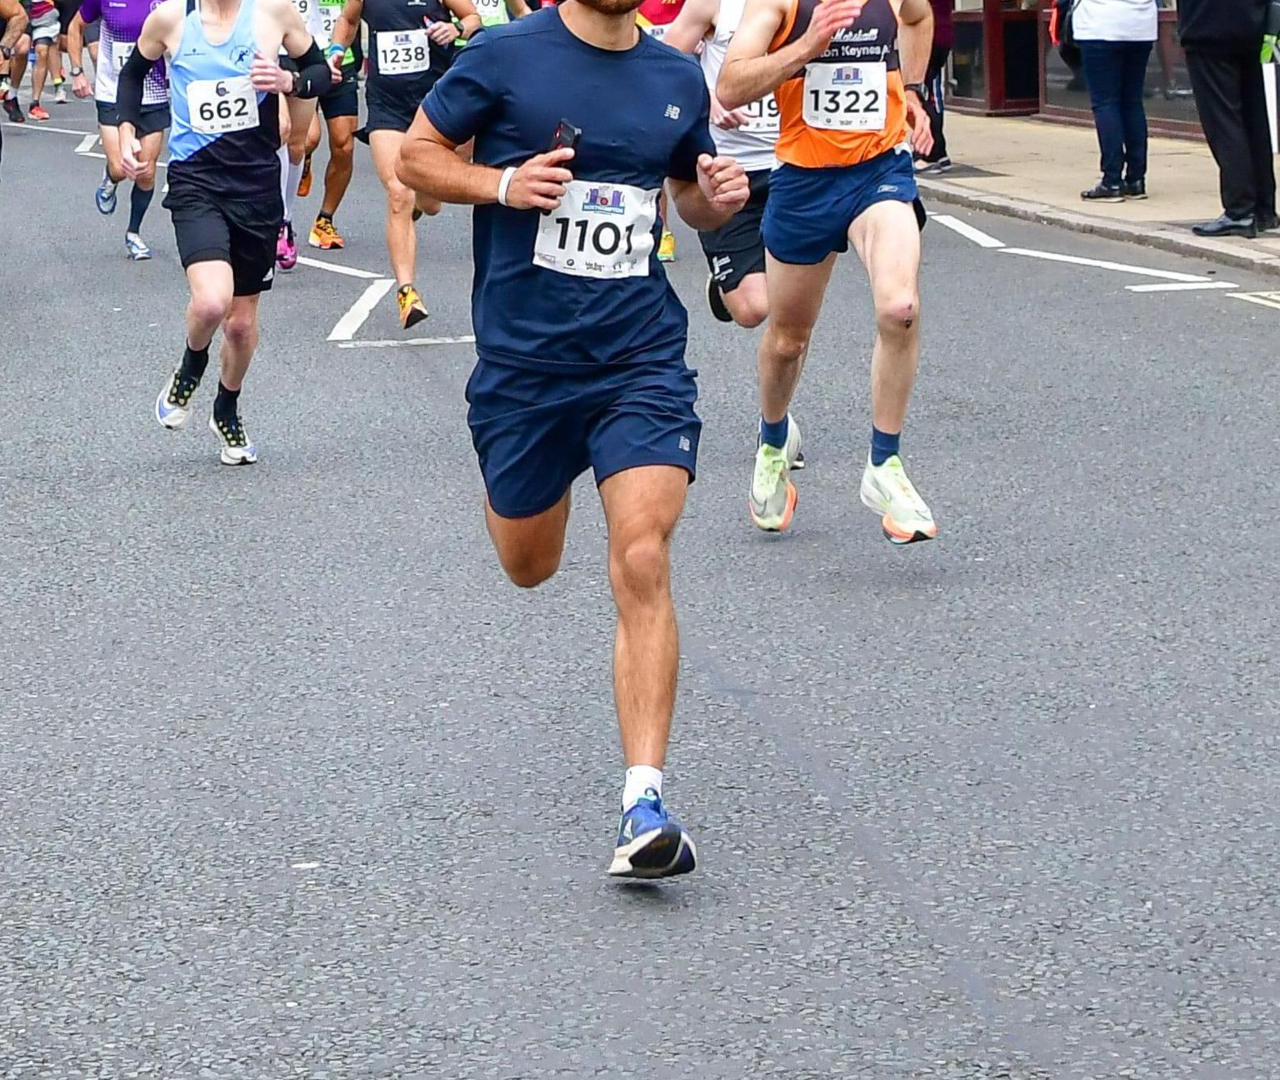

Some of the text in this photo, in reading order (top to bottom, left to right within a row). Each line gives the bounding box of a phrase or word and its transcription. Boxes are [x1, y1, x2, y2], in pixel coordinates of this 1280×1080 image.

[381, 47, 425, 64] 1238
[841, 45, 881, 58] Keynes
[199, 98, 248, 121] 662
[810, 89, 879, 114] 1322
[556, 217, 636, 256] 1101
